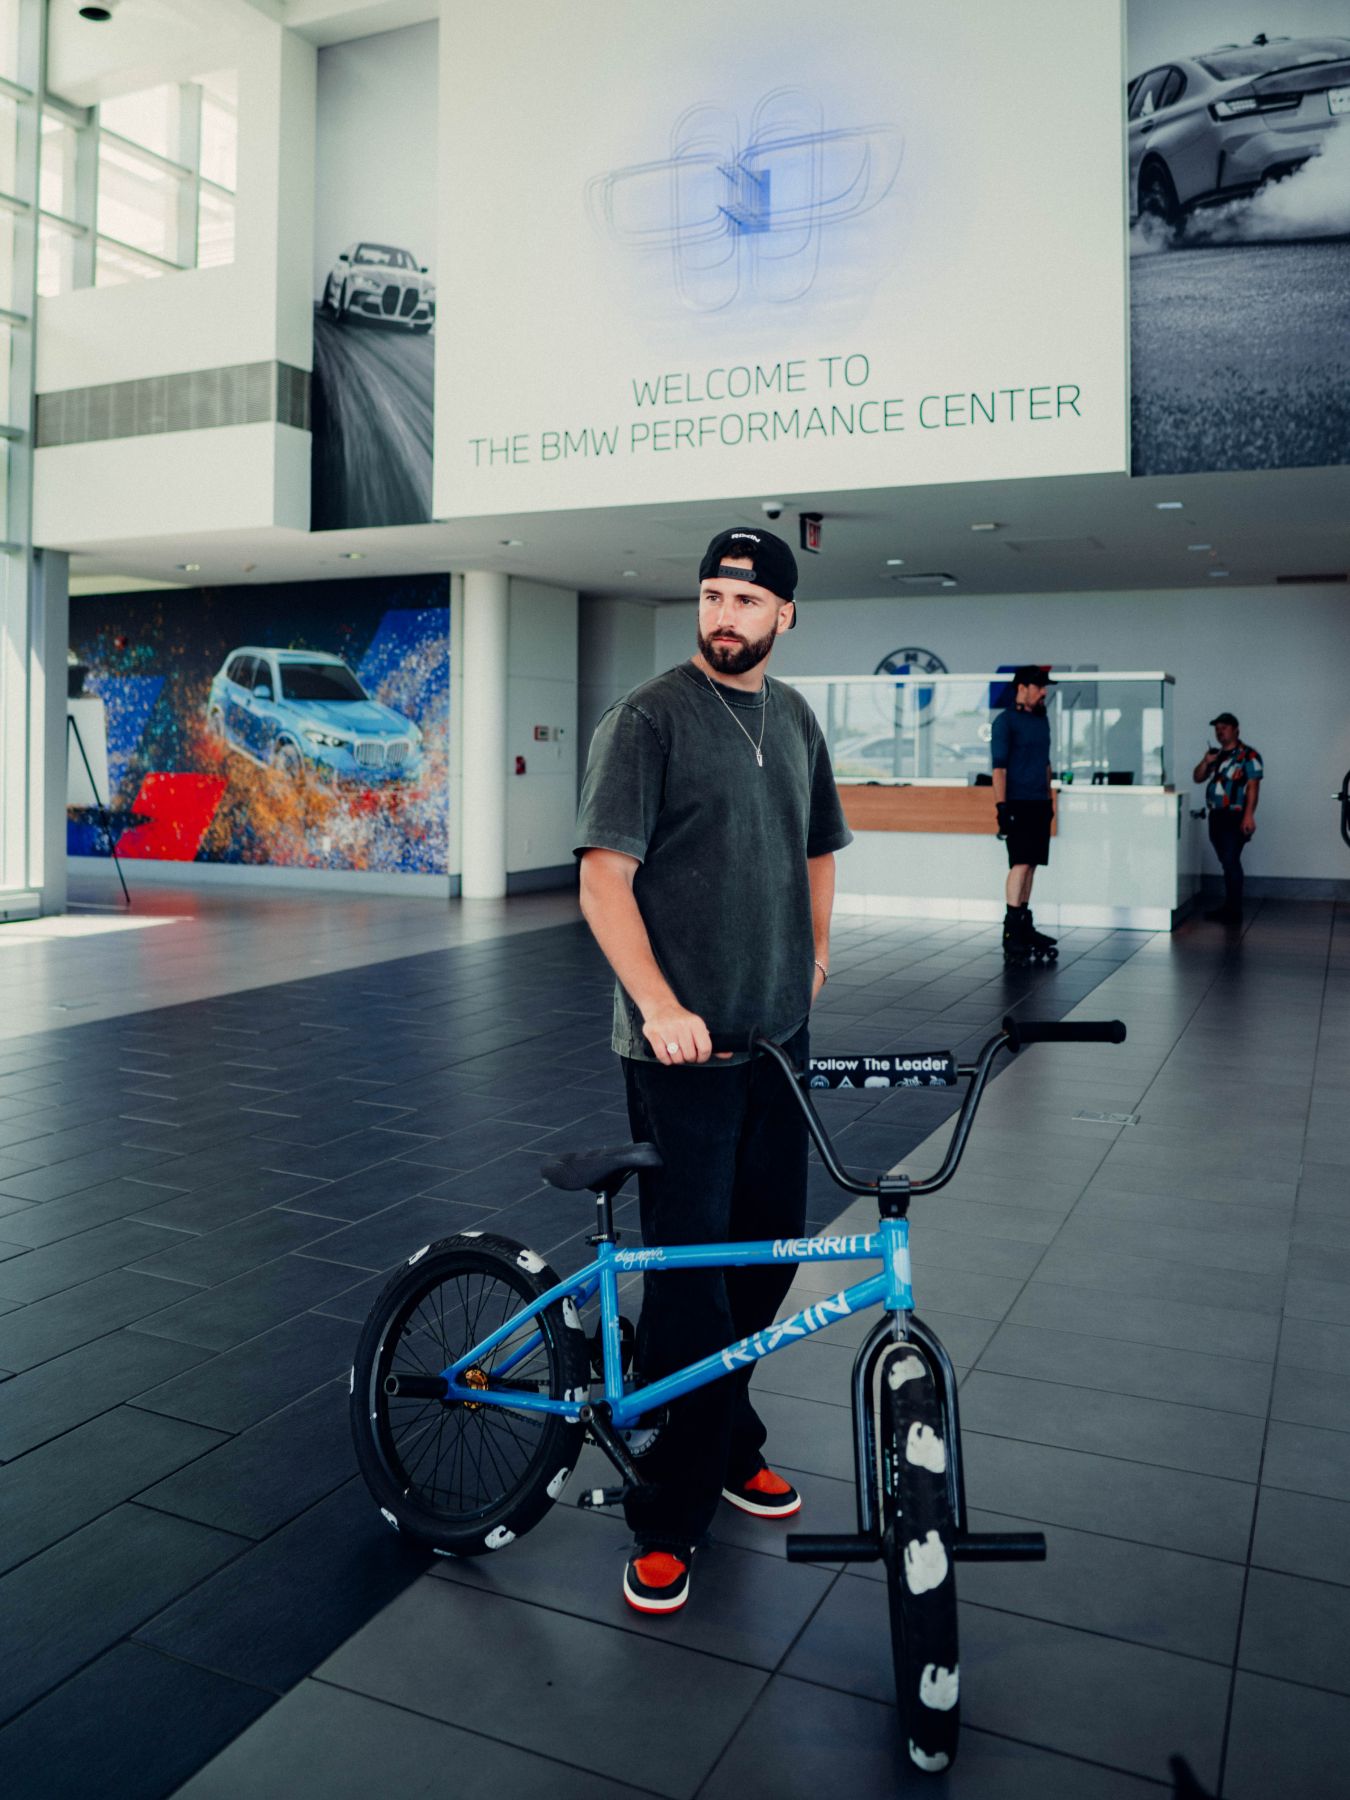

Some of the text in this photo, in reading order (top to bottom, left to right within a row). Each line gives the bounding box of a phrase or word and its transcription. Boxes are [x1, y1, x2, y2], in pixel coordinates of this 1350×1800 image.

[632, 353, 869, 407] WELCOME TO
[468, 384, 1081, 467] THE BMW PERFORMANCE CENTER
[809, 1056, 949, 1071] Follow The Leader
[772, 1233, 877, 1258] MERRITT
